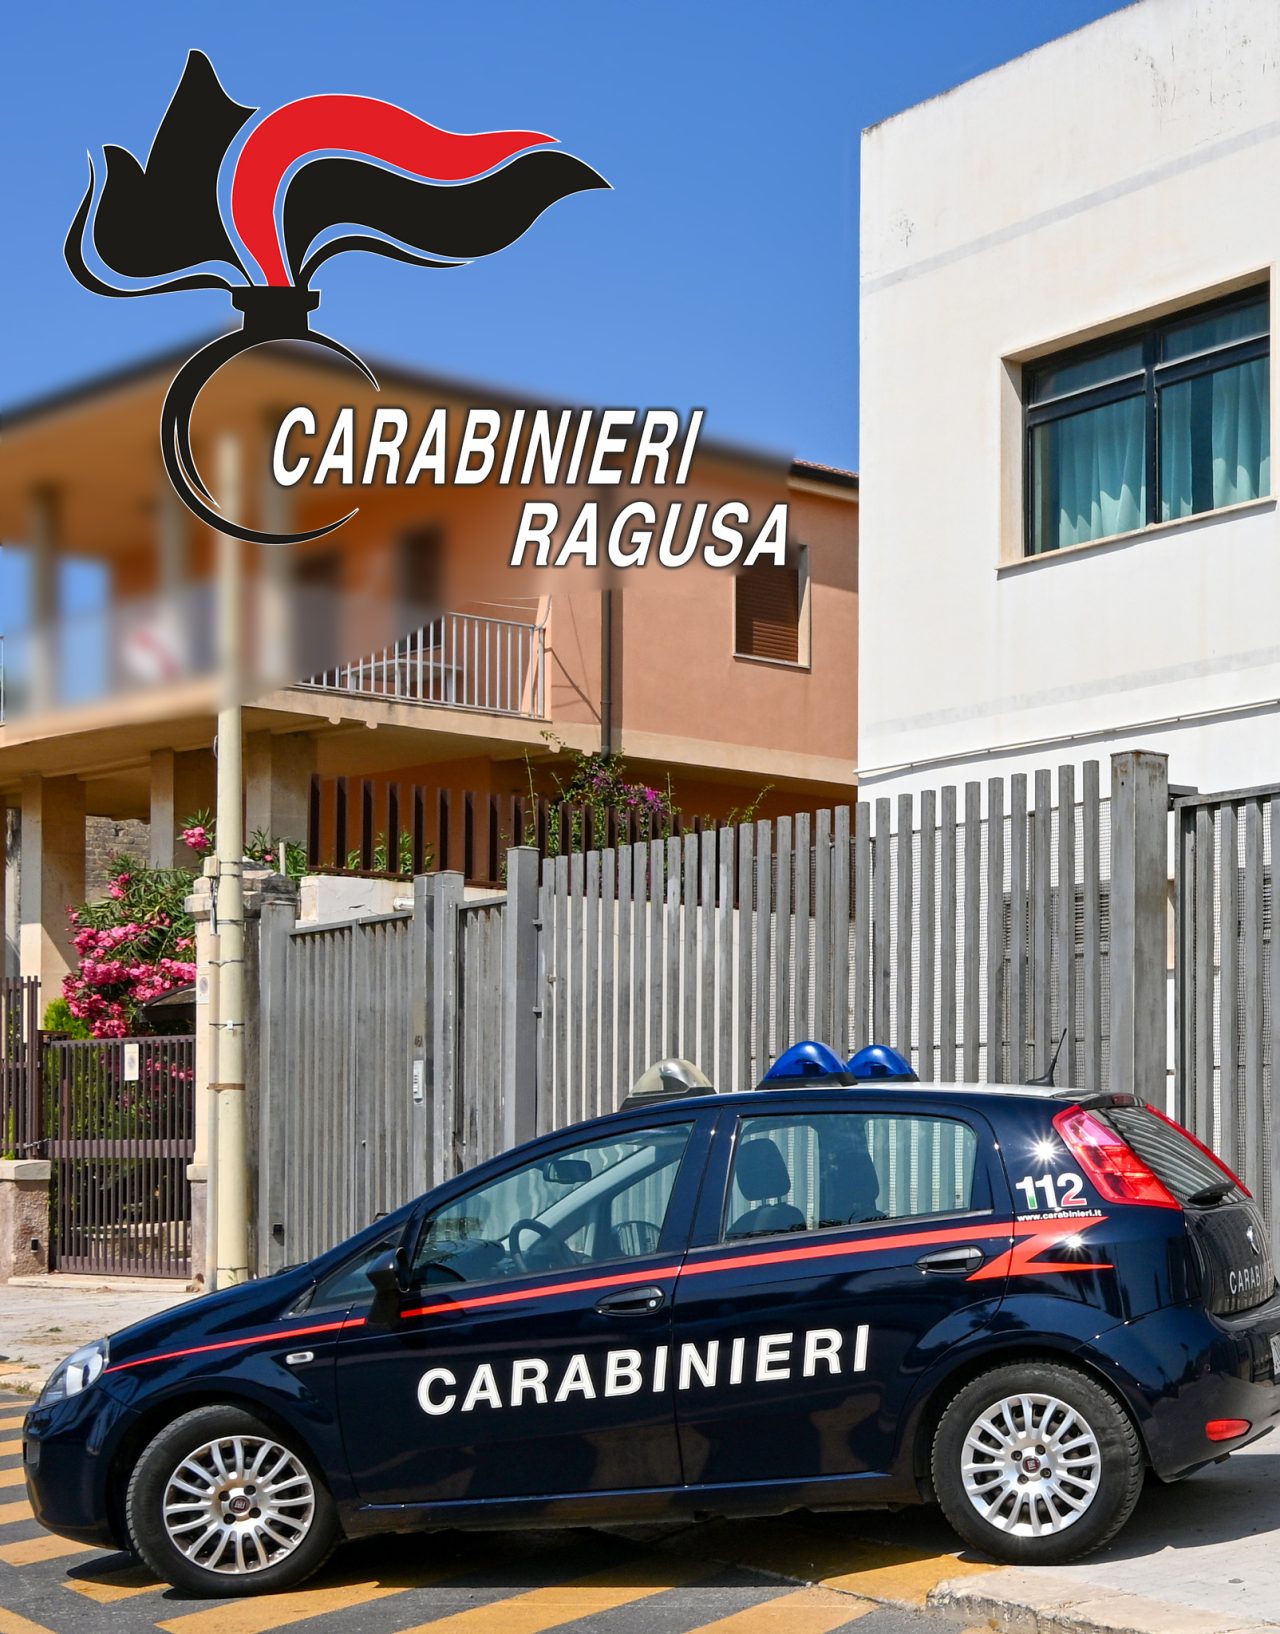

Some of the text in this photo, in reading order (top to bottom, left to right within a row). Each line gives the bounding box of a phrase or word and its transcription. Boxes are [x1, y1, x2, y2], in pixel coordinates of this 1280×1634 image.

[1015, 1172, 1088, 1210] 112
[1016, 1209, 1102, 1222] www.carabinieri.it
[416, 1324, 869, 1416] CARABINIERI
